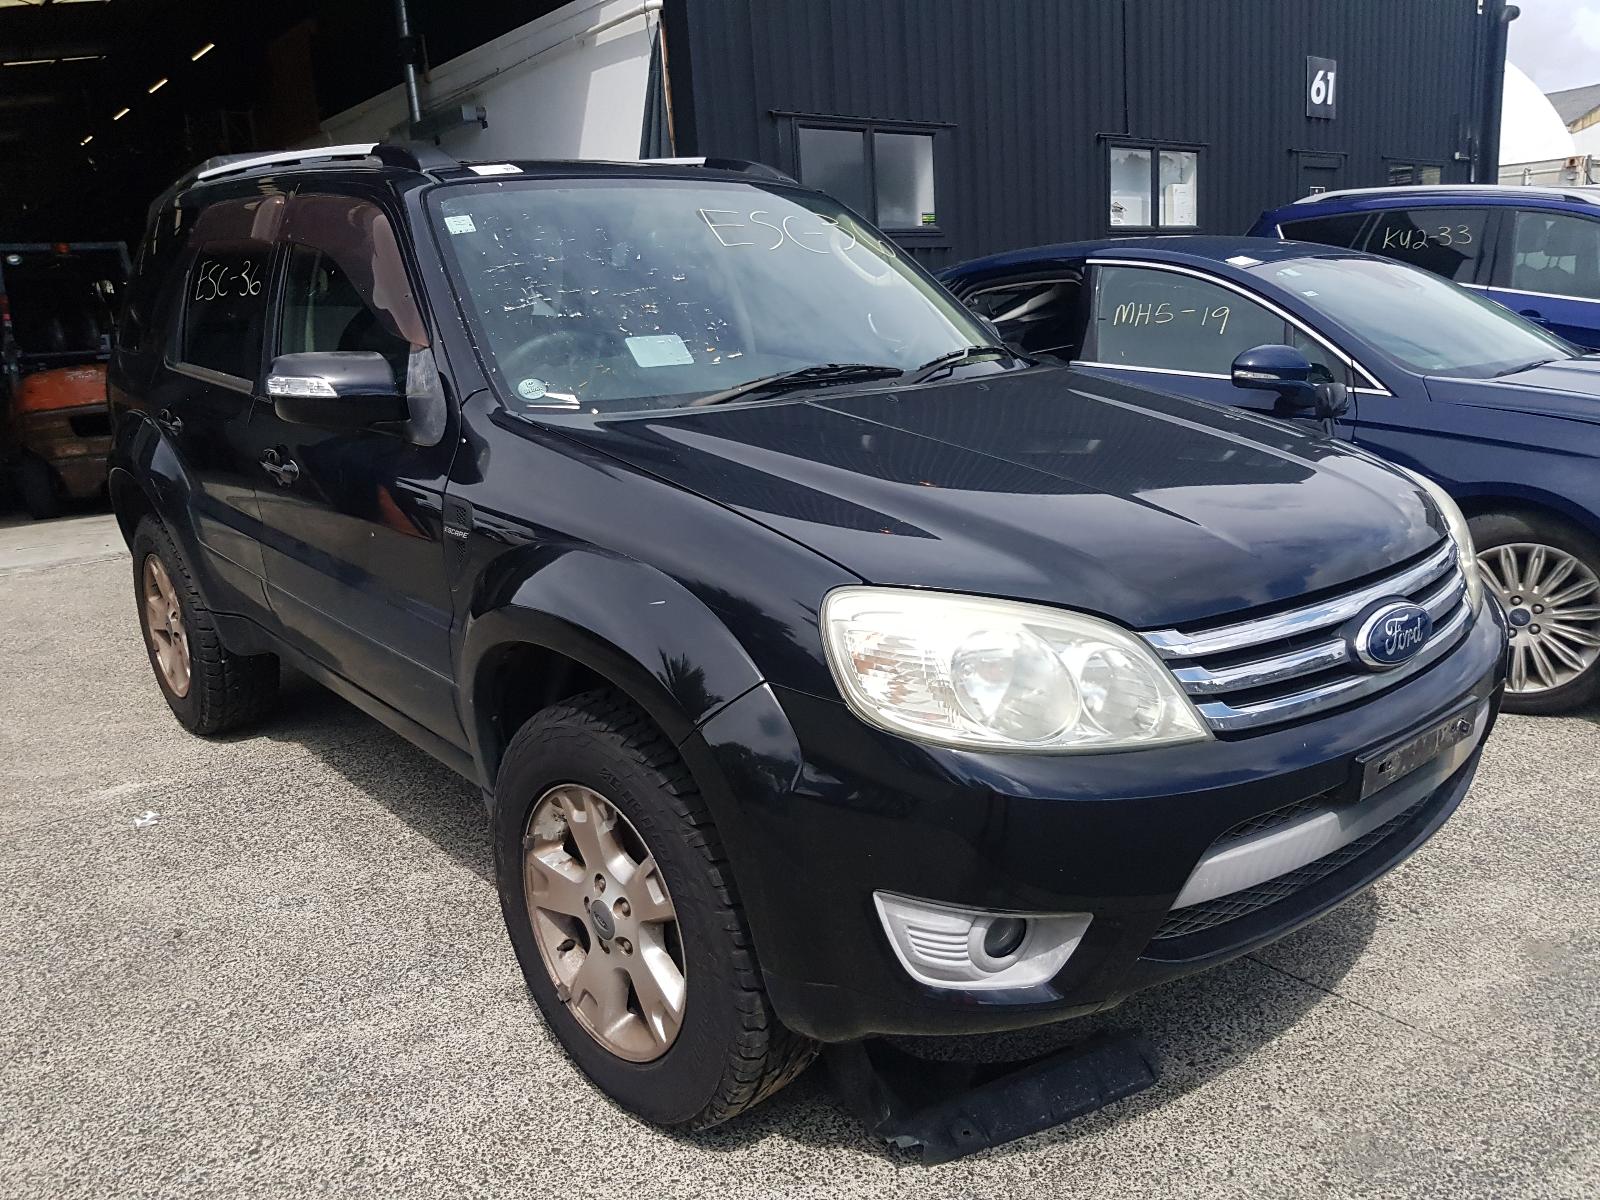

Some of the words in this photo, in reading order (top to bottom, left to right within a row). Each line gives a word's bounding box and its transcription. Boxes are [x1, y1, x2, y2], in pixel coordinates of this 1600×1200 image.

[1310, 70, 1334, 105] 61
[195, 260, 261, 300] ESC-36
[444, 526, 469, 539] ESCAPE
[1385, 613, 1424, 655] Ford
